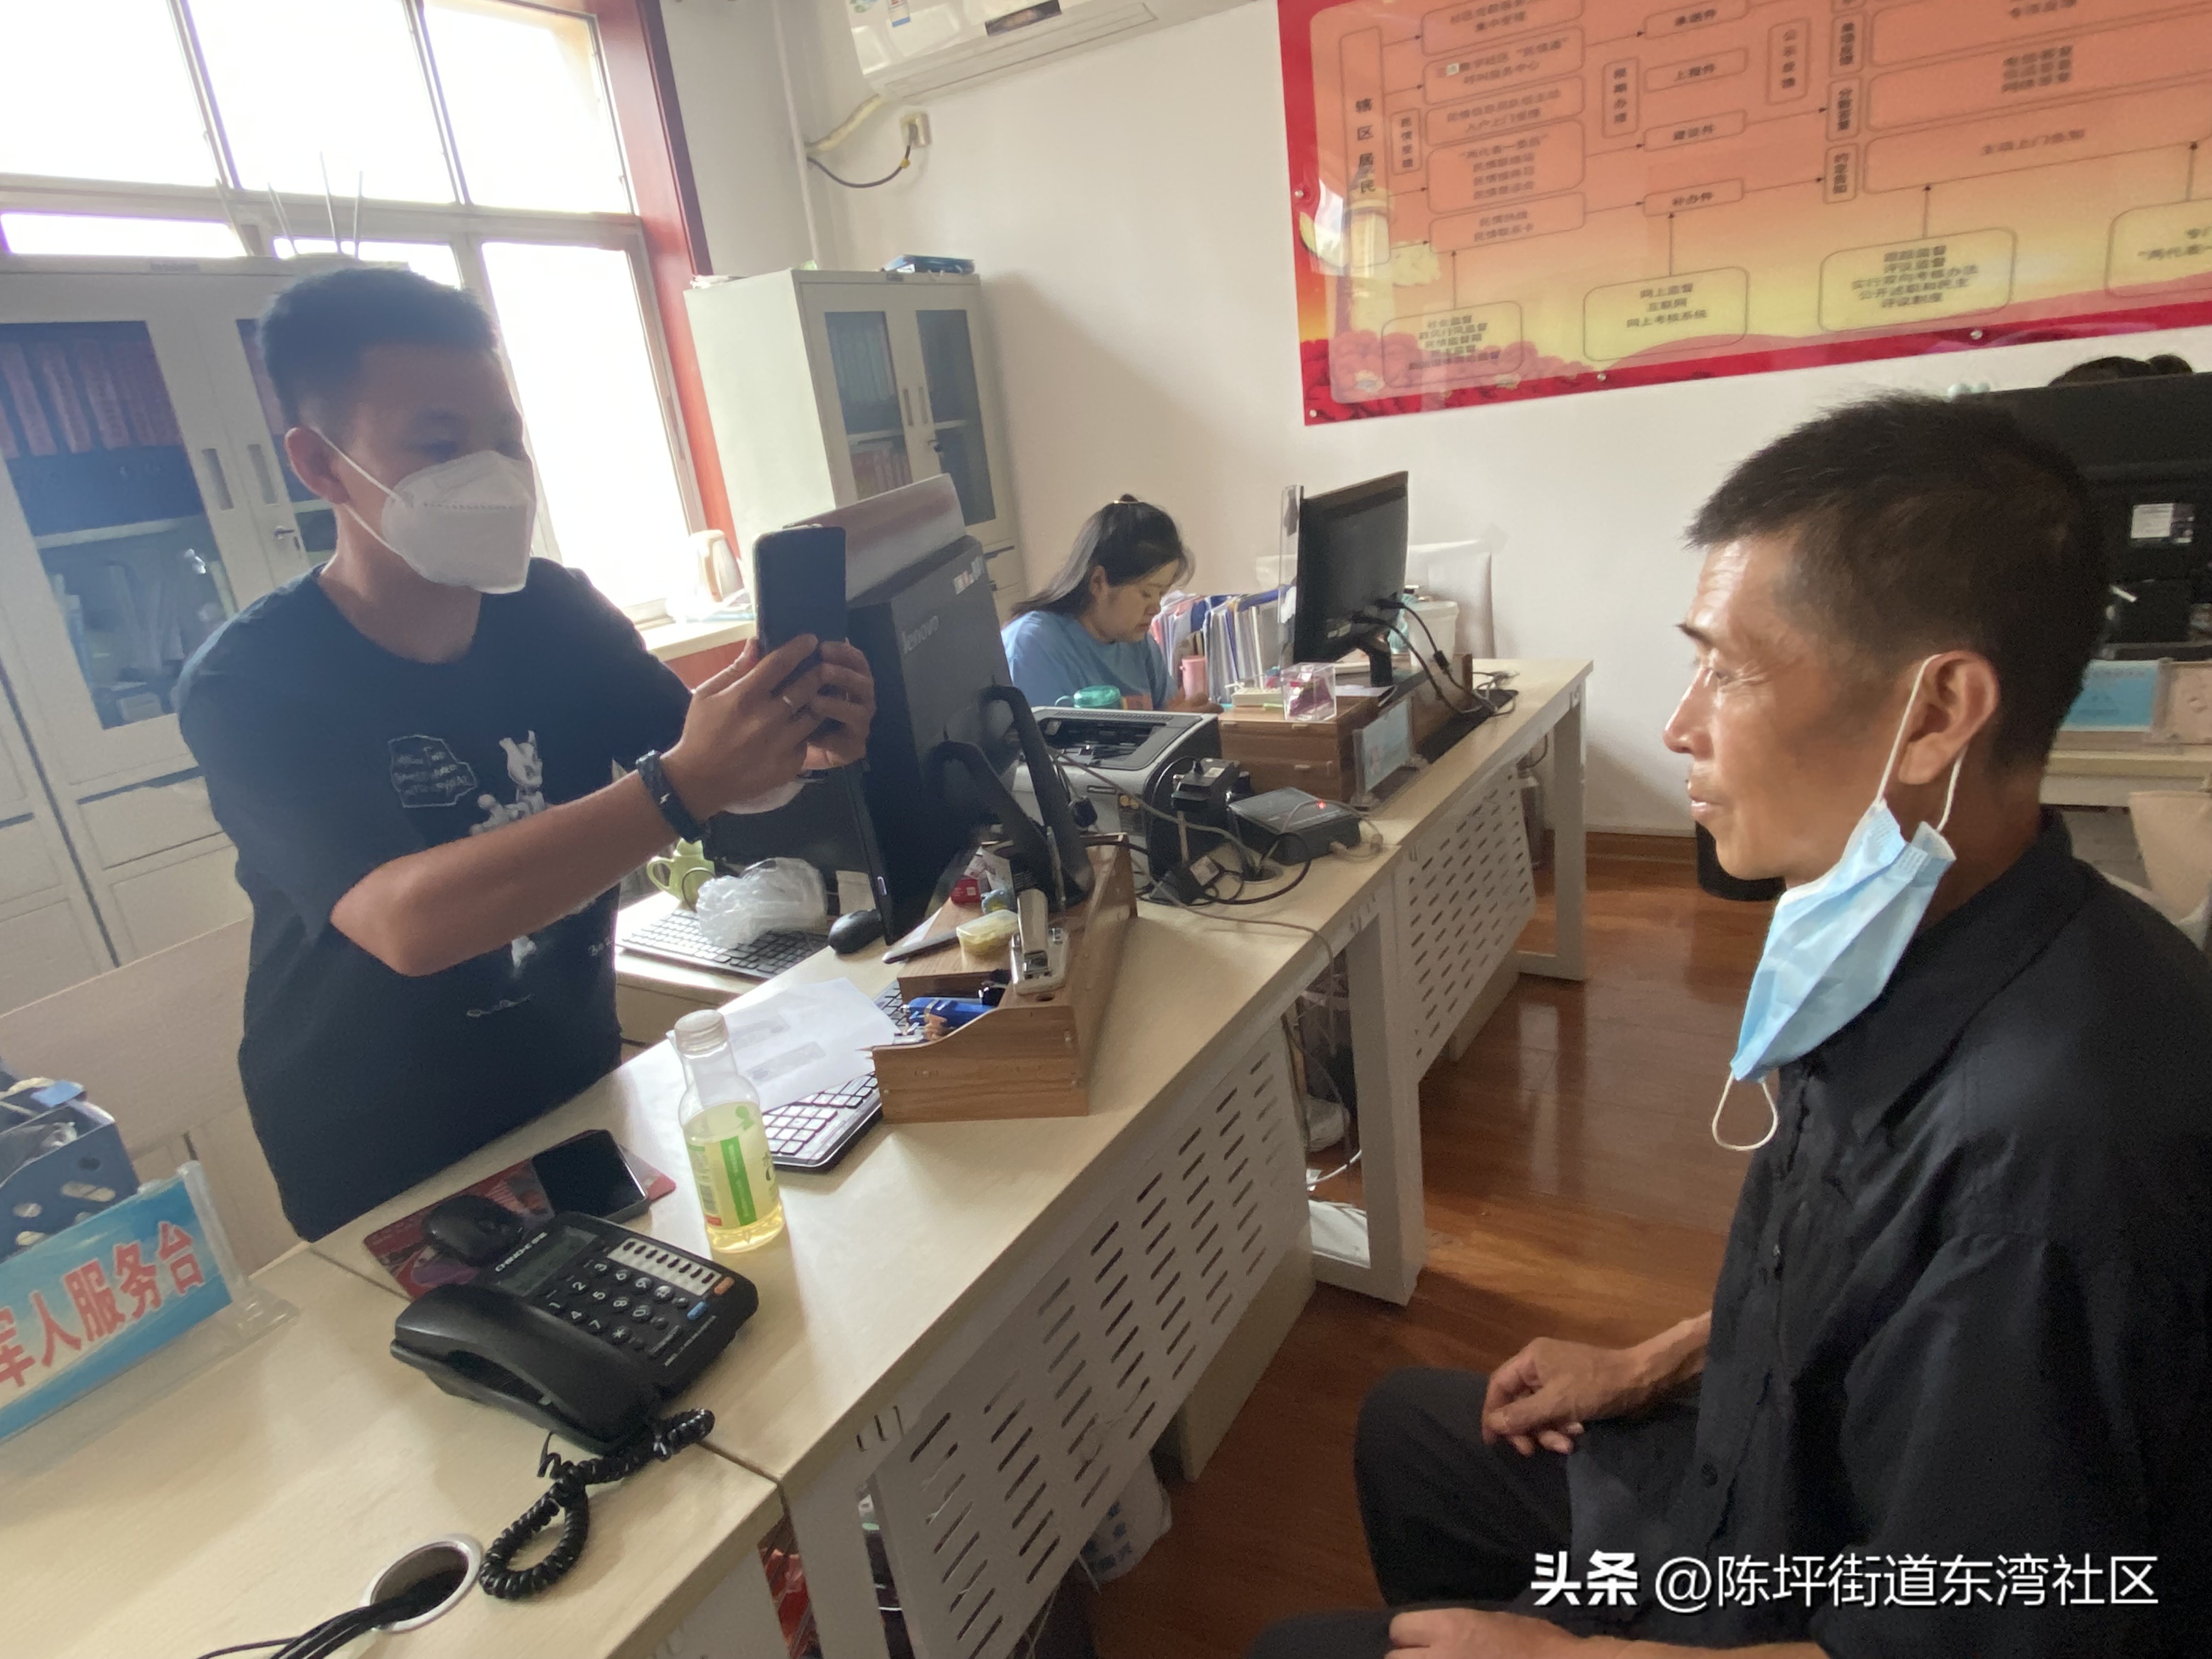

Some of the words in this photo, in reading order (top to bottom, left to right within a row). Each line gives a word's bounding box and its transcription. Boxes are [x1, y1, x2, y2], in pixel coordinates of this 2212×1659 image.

[0, 1220, 206, 1387] 军人服务台
